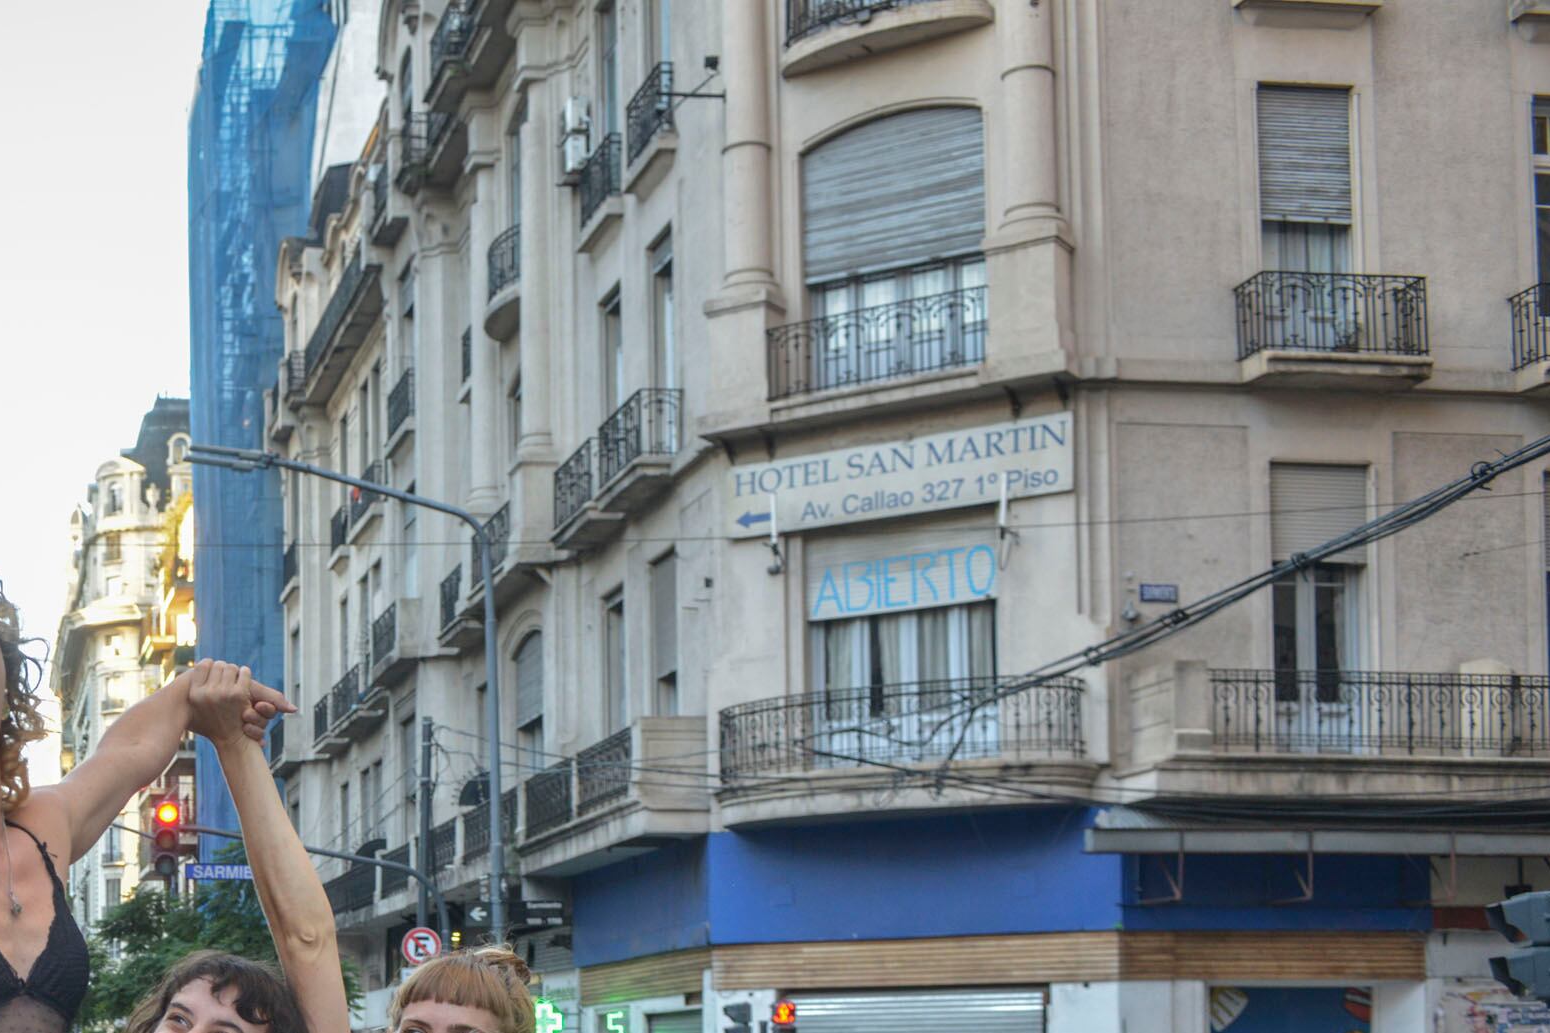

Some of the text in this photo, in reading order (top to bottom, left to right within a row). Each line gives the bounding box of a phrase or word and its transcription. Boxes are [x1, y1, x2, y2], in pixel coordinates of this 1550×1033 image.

[734, 420, 1068, 497] HOTEL SAN MARTIN
[801, 501, 834, 521] Av.
[842, 488, 914, 515] Callao
[921, 478, 965, 504] 327
[1006, 468, 1059, 490] Piso
[812, 544, 998, 616] ABIERTO
